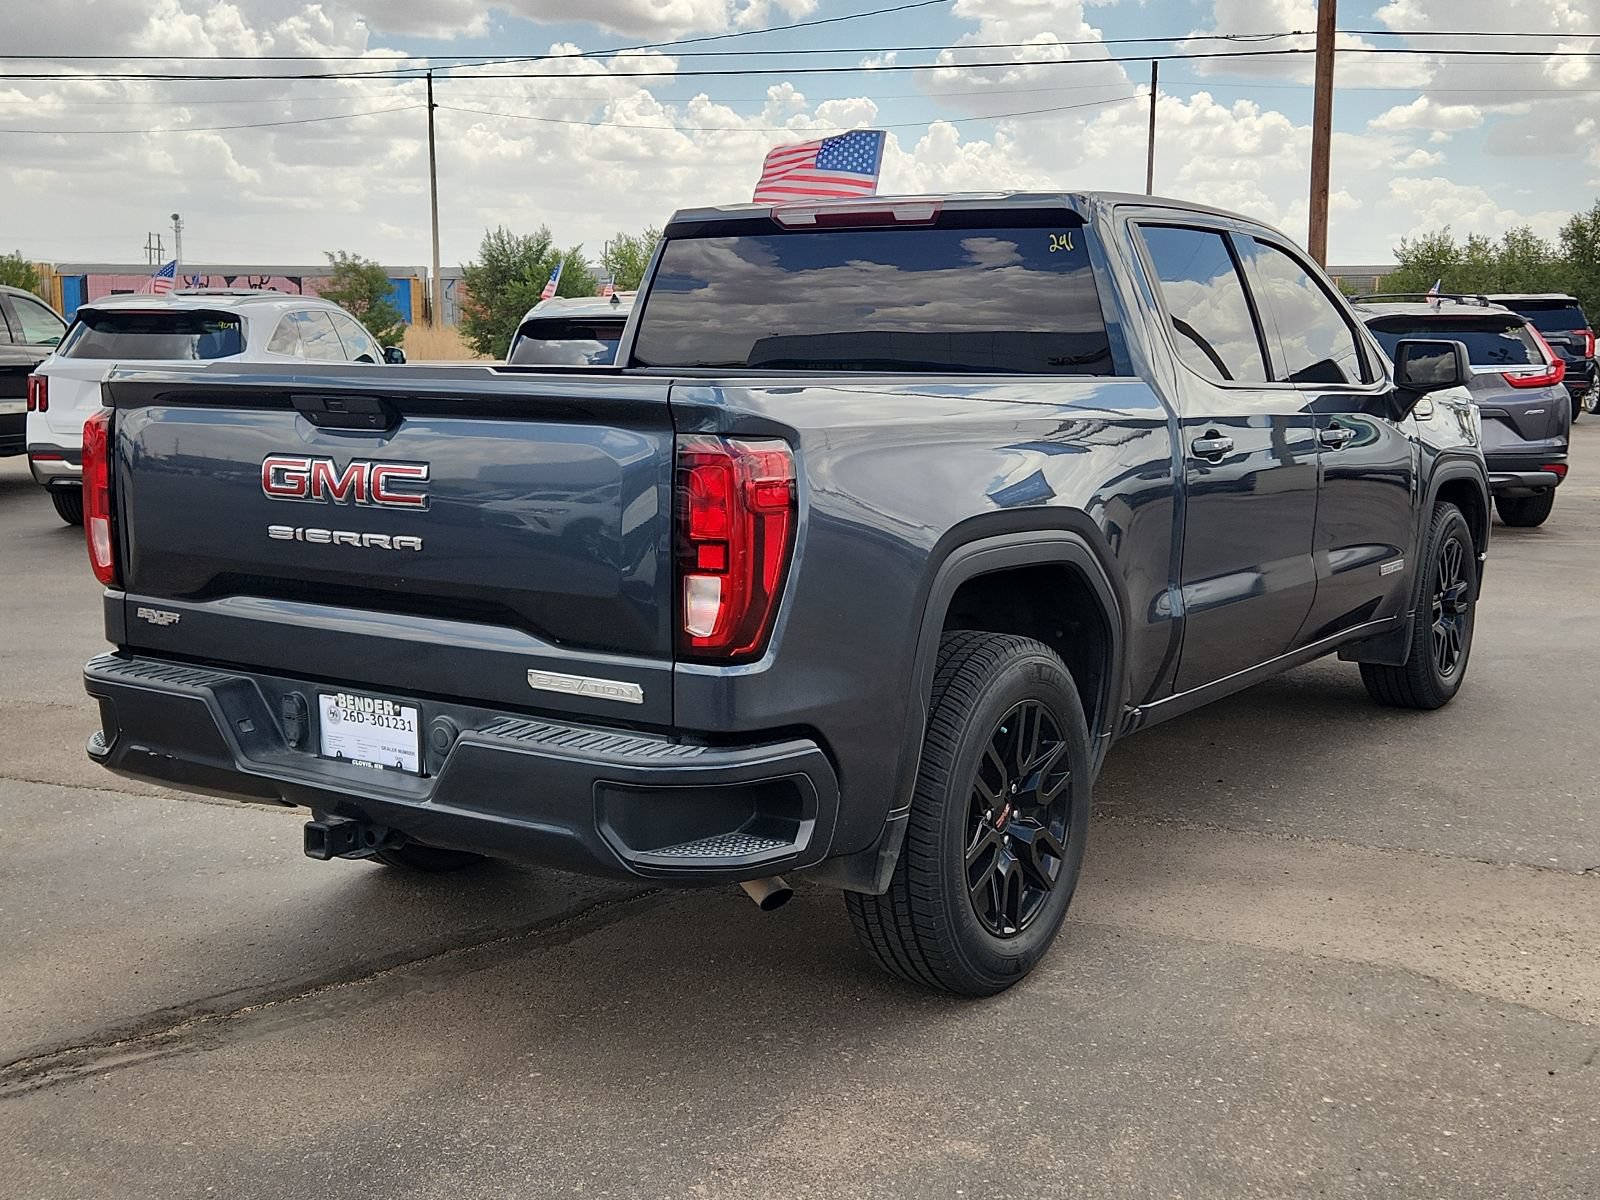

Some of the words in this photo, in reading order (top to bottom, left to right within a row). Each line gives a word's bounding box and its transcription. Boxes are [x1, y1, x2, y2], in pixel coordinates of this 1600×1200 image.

[1049, 232, 1074, 252] 241
[262, 455, 430, 509] GMC
[267, 525, 424, 552] SIERRA
[536, 676, 634, 699] ELEVATION
[336, 692, 394, 716] BENDER
[342, 708, 414, 732] 26D-301231
